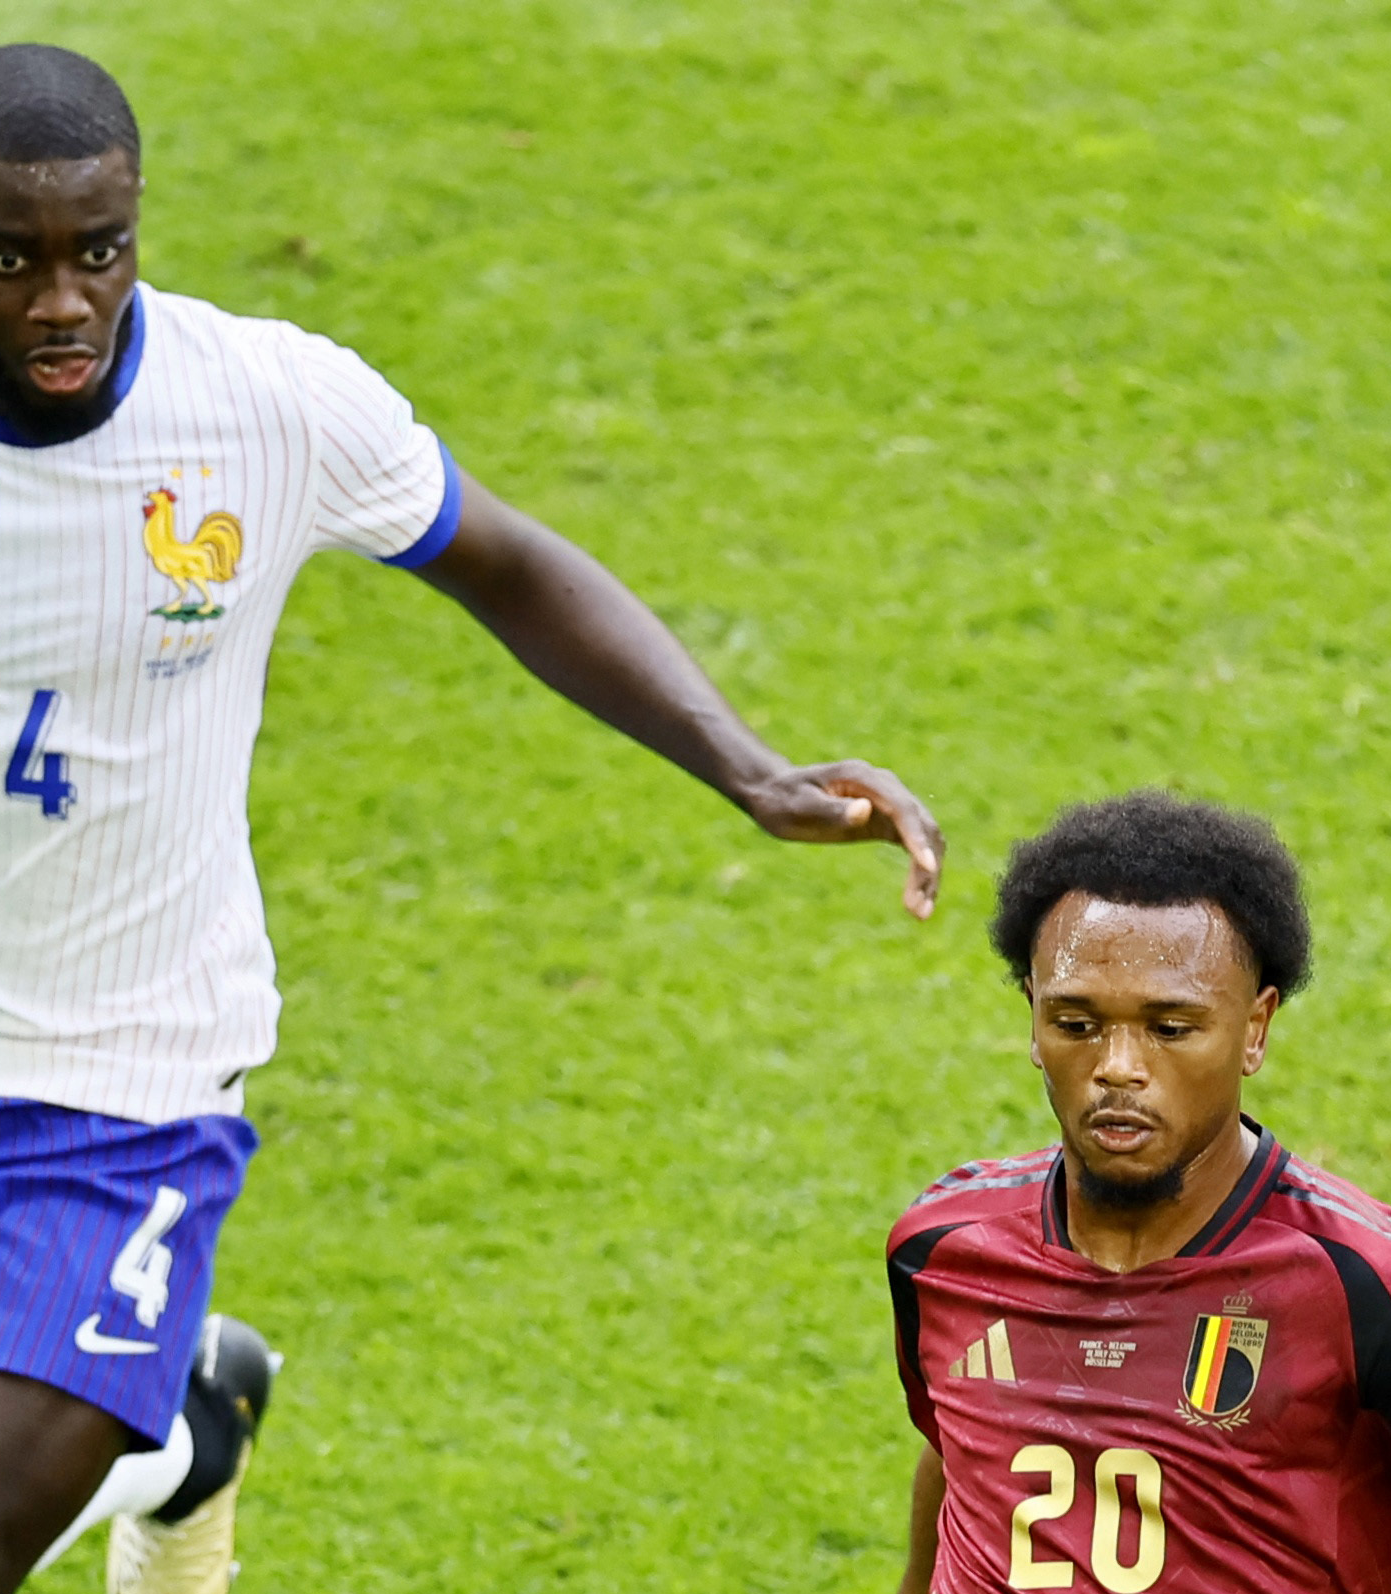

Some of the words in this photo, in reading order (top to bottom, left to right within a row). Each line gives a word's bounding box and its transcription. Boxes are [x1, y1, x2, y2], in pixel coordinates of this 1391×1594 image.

[5, 689, 77, 820] 4
[110, 1185, 187, 1329] 4
[1008, 1444, 1166, 1594] 20
